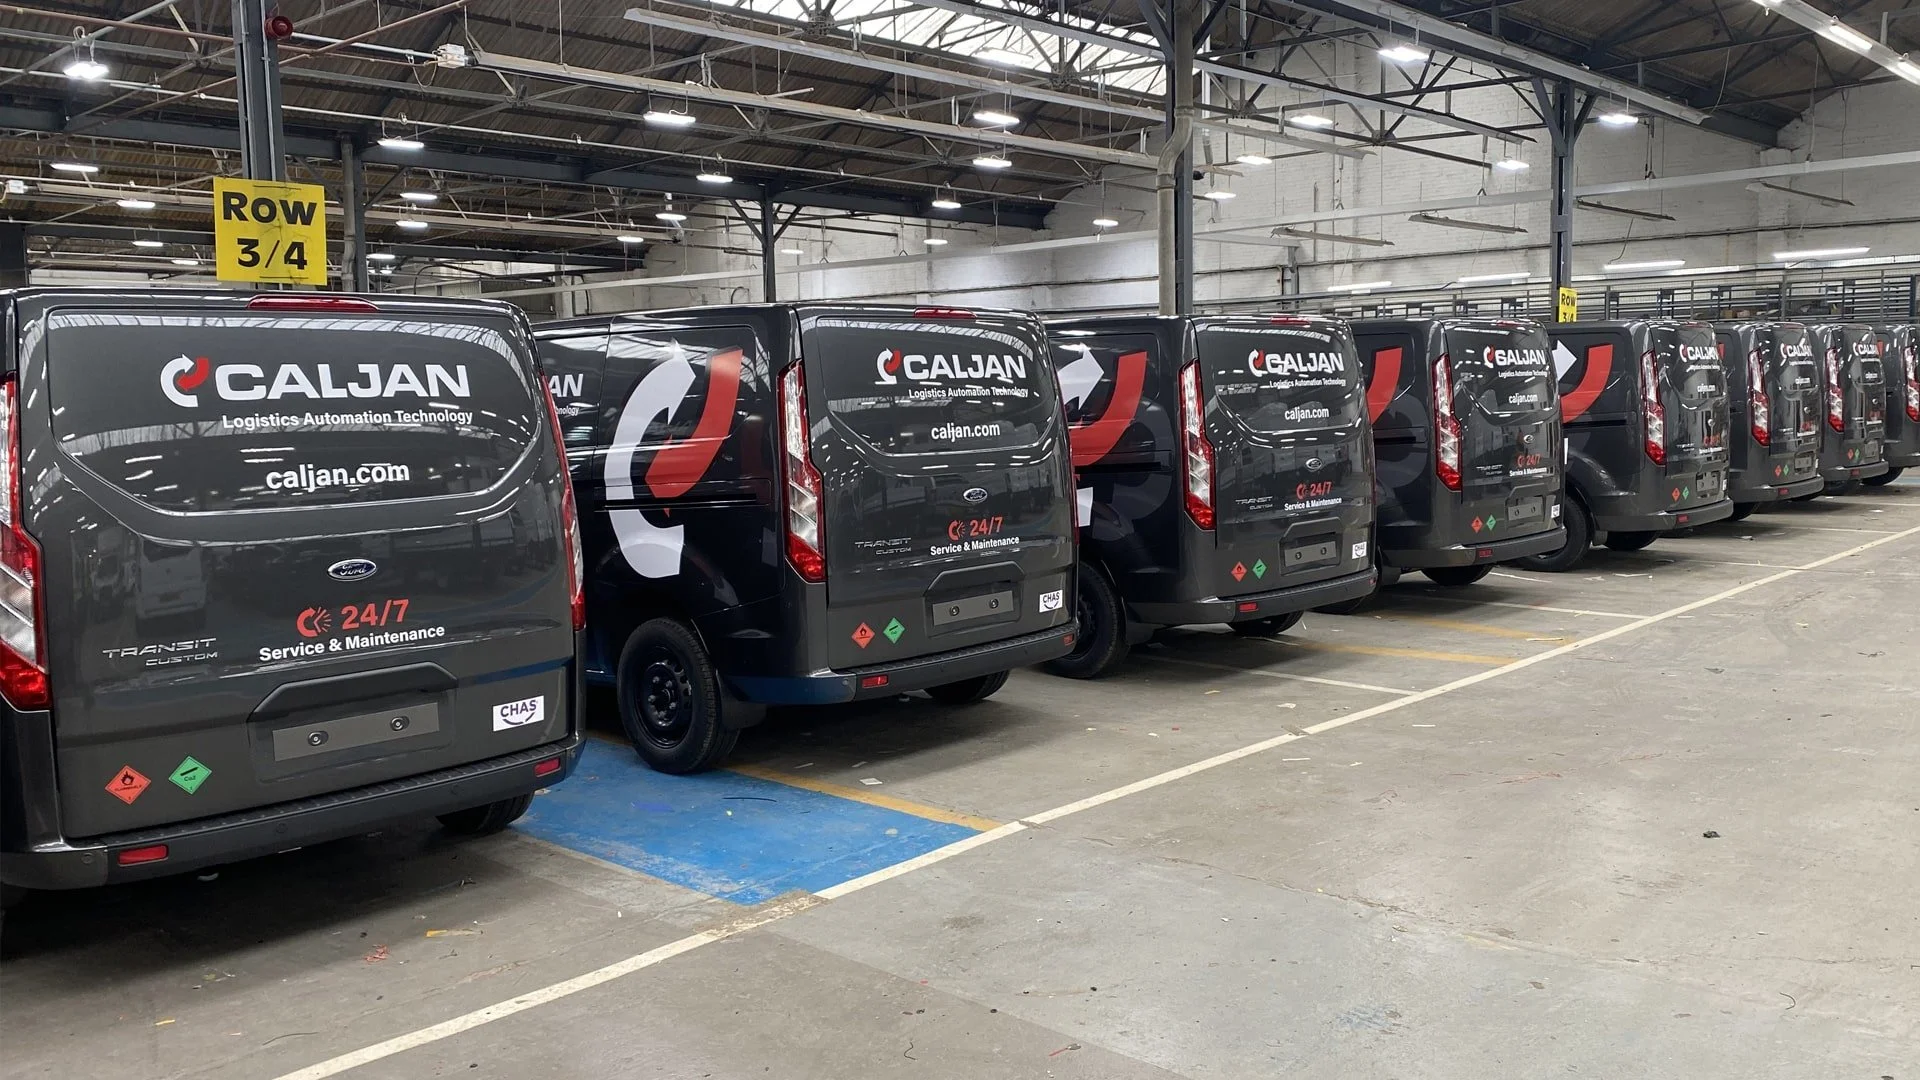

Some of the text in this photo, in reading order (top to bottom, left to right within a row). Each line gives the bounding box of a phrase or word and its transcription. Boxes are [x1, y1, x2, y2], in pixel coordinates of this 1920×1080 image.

[237, 238, 307, 270] 3/4
[903, 354, 1026, 380] CALJAN
[1265, 352, 1345, 374] CALJAN
[215, 363, 471, 401] CALJAN
[1269, 380, 1294, 389] Logistics
[1295, 379, 1322, 387] Automation
[908, 387, 1029, 400] Logistics Automation Technology
[222, 409, 473, 431] Logistics Automation Technology
[1285, 407, 1329, 422] caljan.com
[931, 423, 1001, 442] caljan.com
[266, 464, 410, 492] caljan.com
[1310, 482, 1333, 497] 24/7
[1284, 503, 1305, 511] Service
[1311, 497, 1342, 508] Maintenance
[970, 517, 1004, 537] 24/7
[854, 537, 912, 548] TRANSIT
[875, 547, 912, 555] CUSTOM
[930, 536, 1020, 556] Service & Maintenance
[1042, 592, 1060, 603] CHAS
[341, 598, 409, 630] 24/7
[102, 638, 217, 659] TRANSIT
[259, 625, 445, 662] Service & Maintenance
[145, 652, 218, 666] CUSTOM
[500, 700, 537, 717] CHAS
